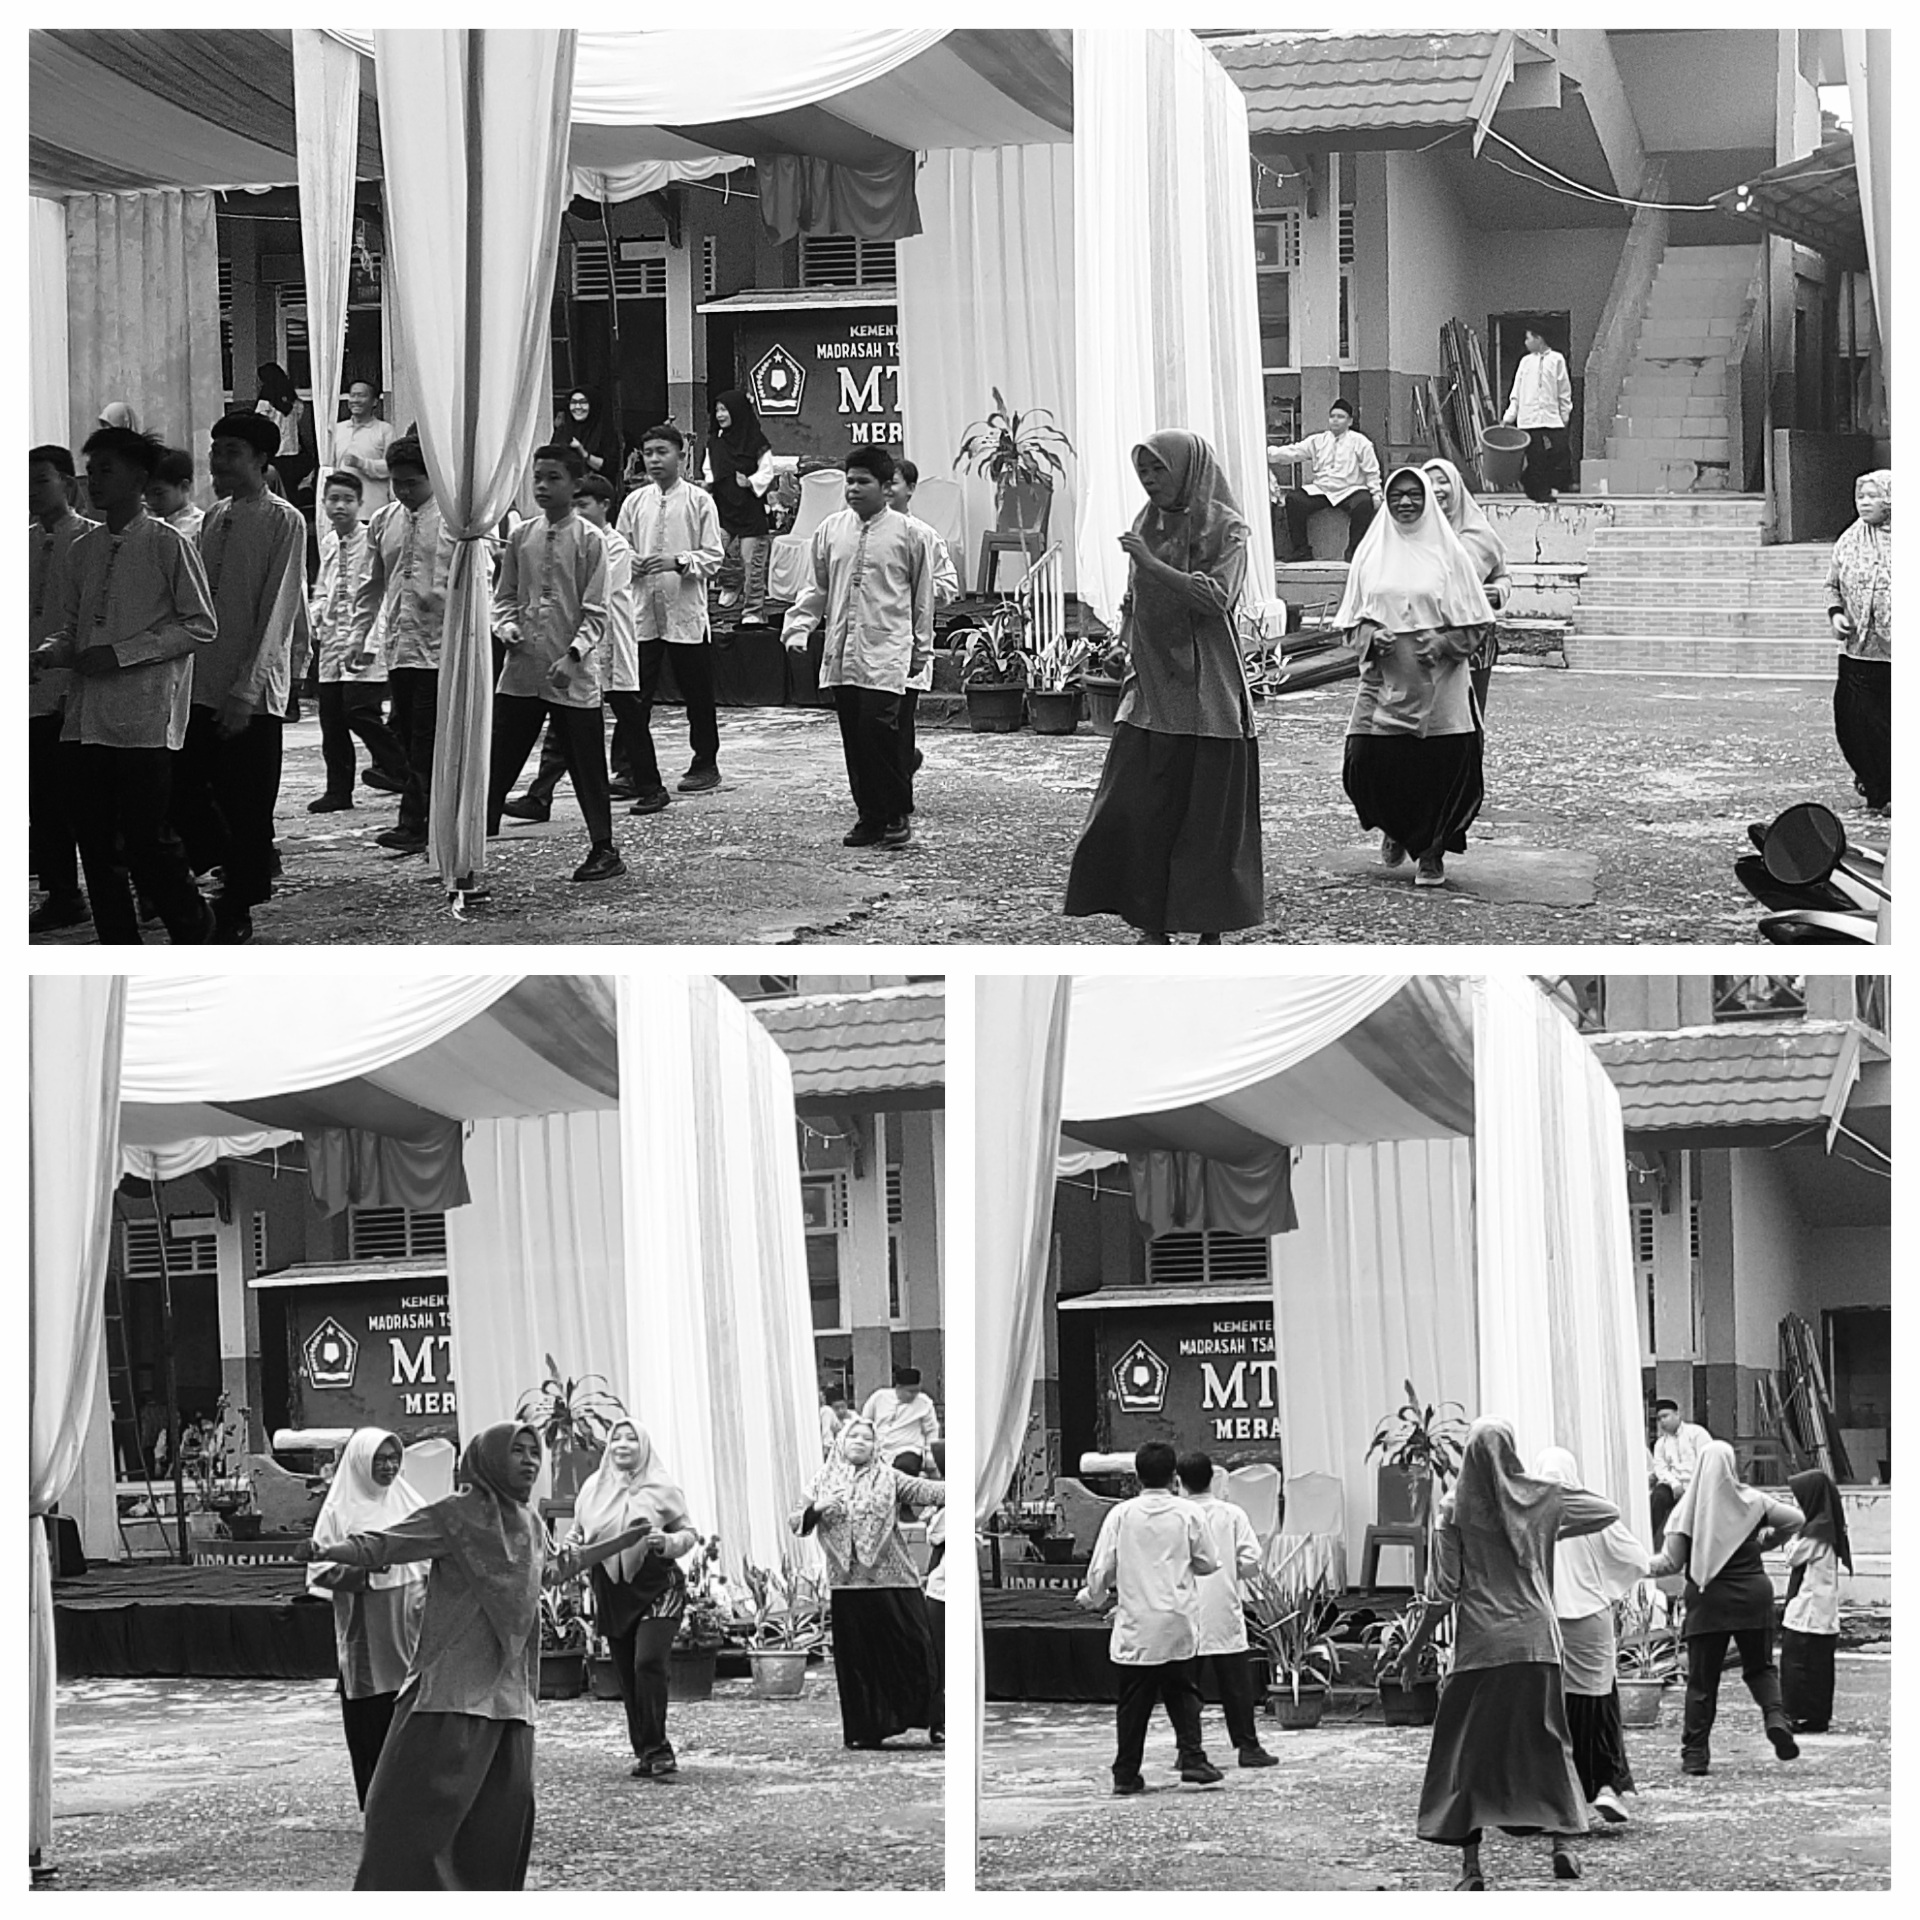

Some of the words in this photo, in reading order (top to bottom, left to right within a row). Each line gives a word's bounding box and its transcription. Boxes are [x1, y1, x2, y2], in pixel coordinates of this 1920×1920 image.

[816, 342, 882, 359] MADRASAH
[368, 1312, 433, 1331] MADRASAH
[1179, 1337, 1245, 1355] MADRASAH
